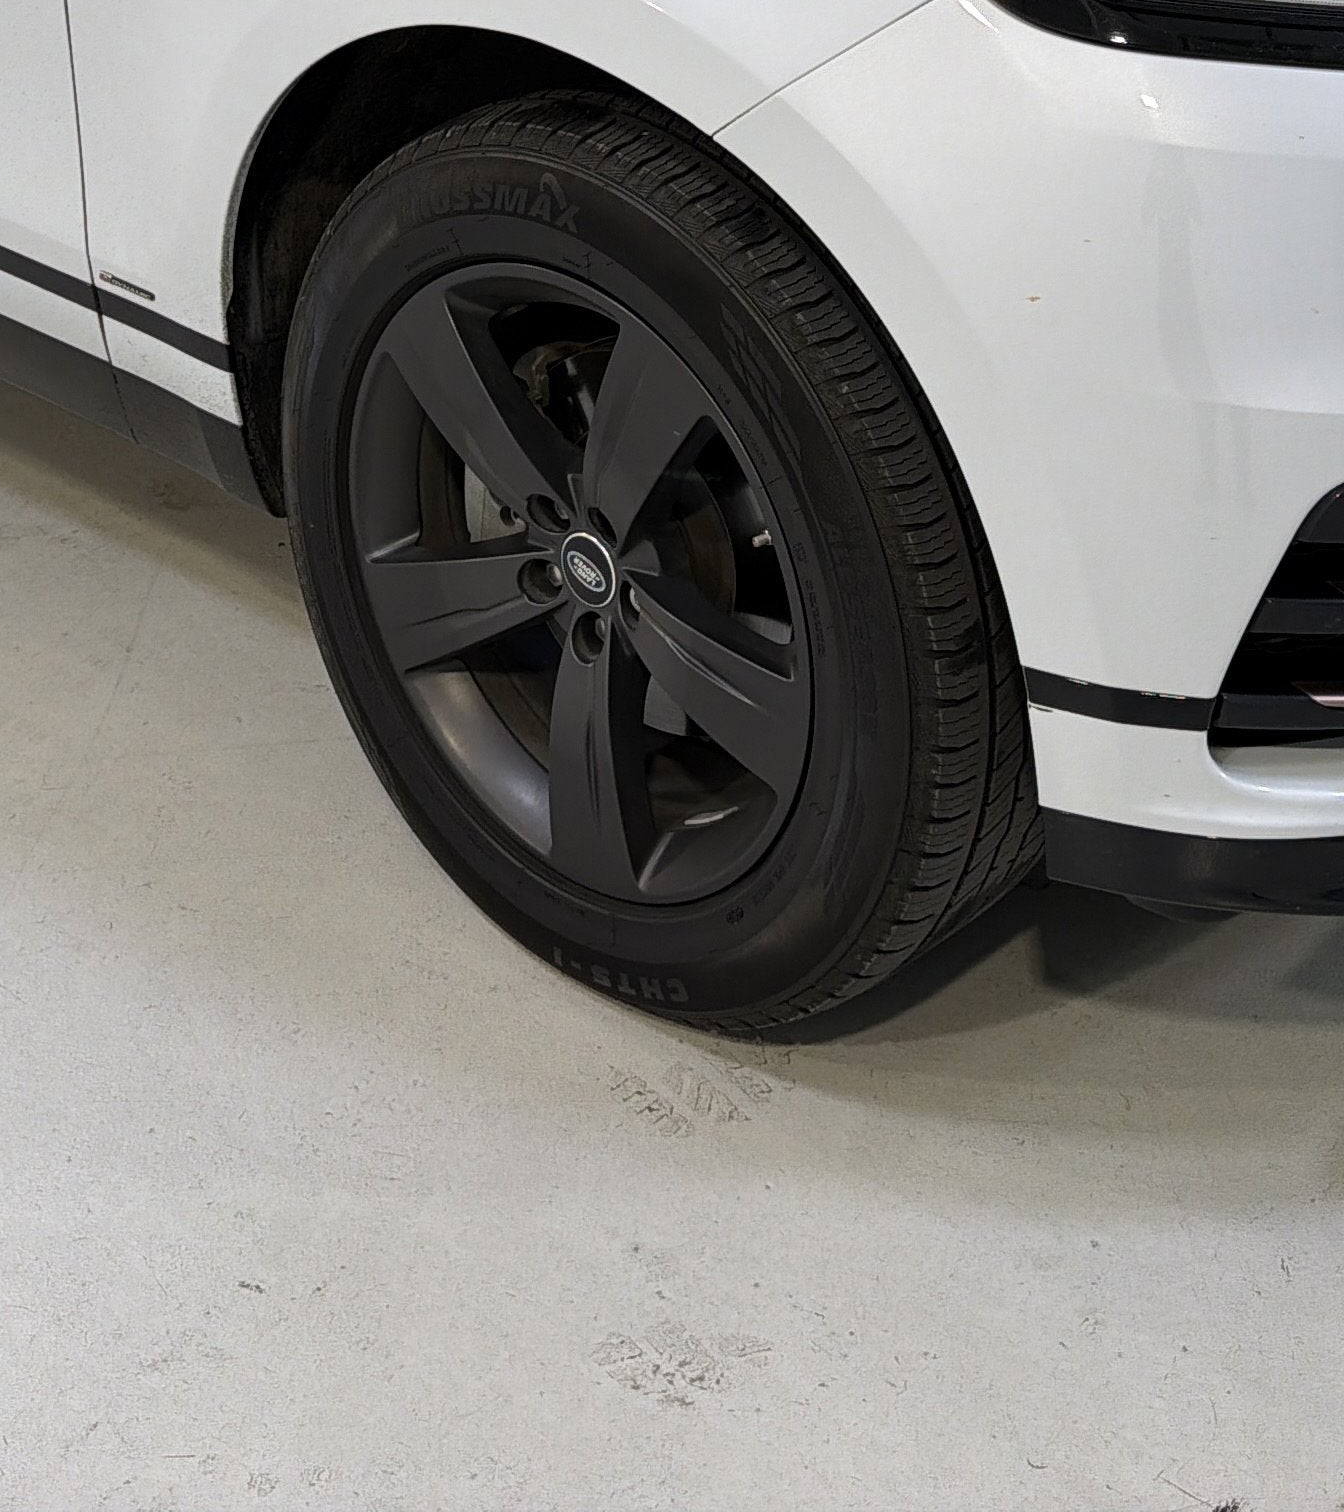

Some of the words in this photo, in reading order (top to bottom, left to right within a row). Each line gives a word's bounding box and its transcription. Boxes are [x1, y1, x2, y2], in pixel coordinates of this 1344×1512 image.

[398, 173, 581, 234] OSSMAX
[573, 557, 597, 579] ROVER
[577, 568, 596, 586] LAND
[553, 946, 690, 1002] CHTS-1
